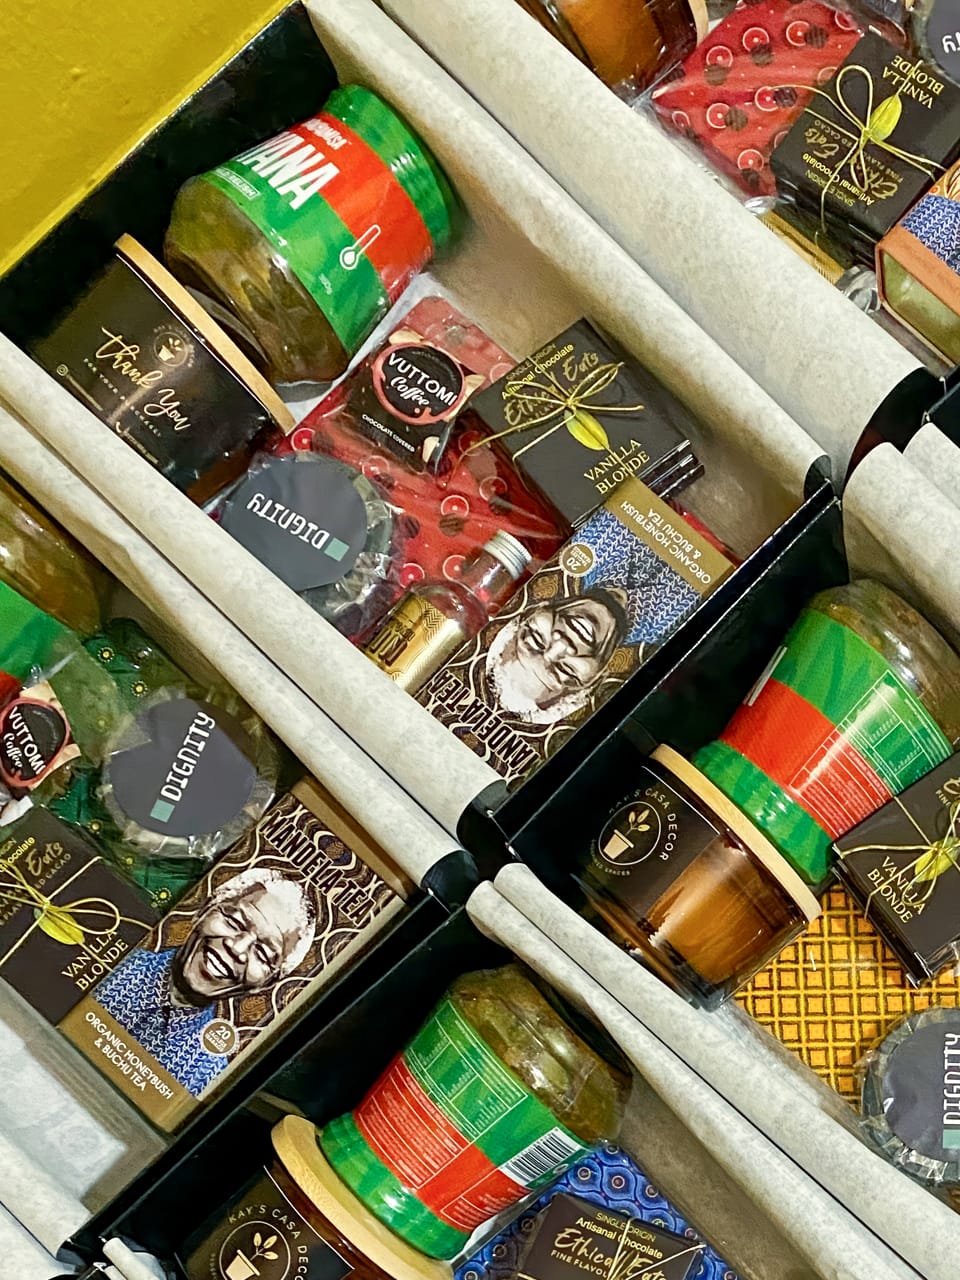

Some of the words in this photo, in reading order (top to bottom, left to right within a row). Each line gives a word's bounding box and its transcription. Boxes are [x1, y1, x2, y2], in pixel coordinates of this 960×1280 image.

[387, 353, 458, 405] VUTTOMI
[390, 377, 430, 407] Coffee
[247, 491, 330, 553] DIGNITY
[621, 499, 669, 546] HONEYBUSH
[648, 508, 666, 528] TEA
[666, 524, 694, 551] BUCHU
[669, 543, 712, 584] ORGANIC
[692, 548, 702, 559] &
[427, 669, 471, 713] TEA
[8, 706, 47, 774] VUTTOMI
[160, 711, 216, 801] DIGNITY
[644, 787, 671, 813] CASA
[659, 812, 678, 862] DECOR
[333, 880, 377, 927] TEA
[867, 868, 914, 924] BLONDE
[75, 939, 129, 991] BLONDE
[84, 1011, 127, 1058] ORGANIC
[124, 1050, 174, 1100] HONEYBUSH
[94, 1036, 103, 1048] &
[102, 1043, 130, 1073] BUCHU
[126, 1070, 147, 1091] TEA
[271, 1207, 301, 1238] CASA
[575, 1216, 618, 1241] Artisanal
[550, 1249, 574, 1267] FINE
